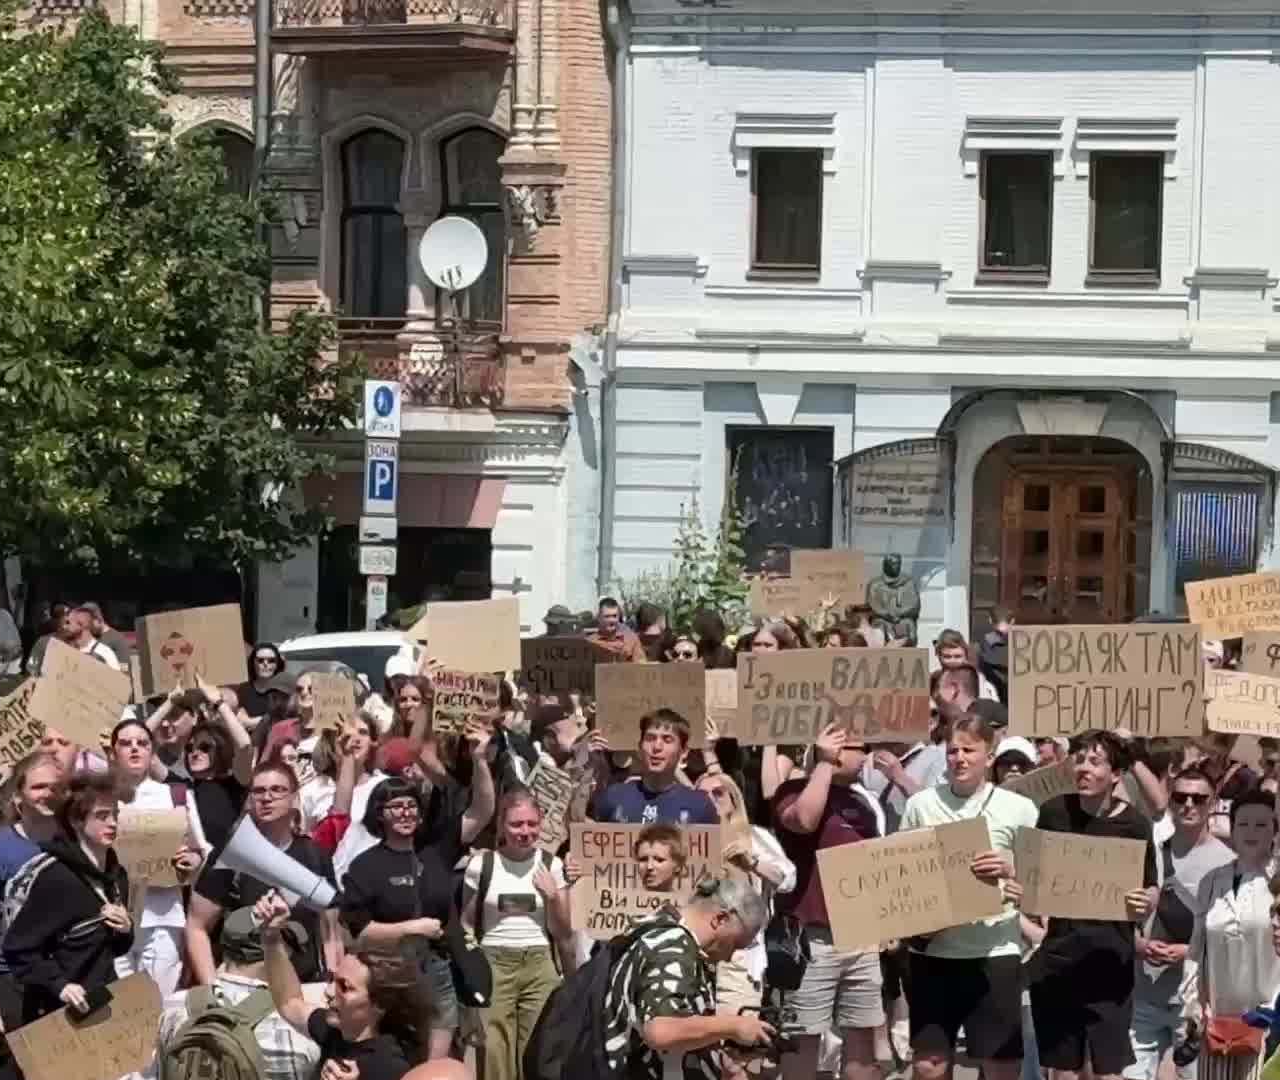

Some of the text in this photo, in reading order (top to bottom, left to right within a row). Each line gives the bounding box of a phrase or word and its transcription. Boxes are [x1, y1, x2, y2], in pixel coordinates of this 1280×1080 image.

[1011, 630, 1201, 678] ВОВА ЯК ТАМ
